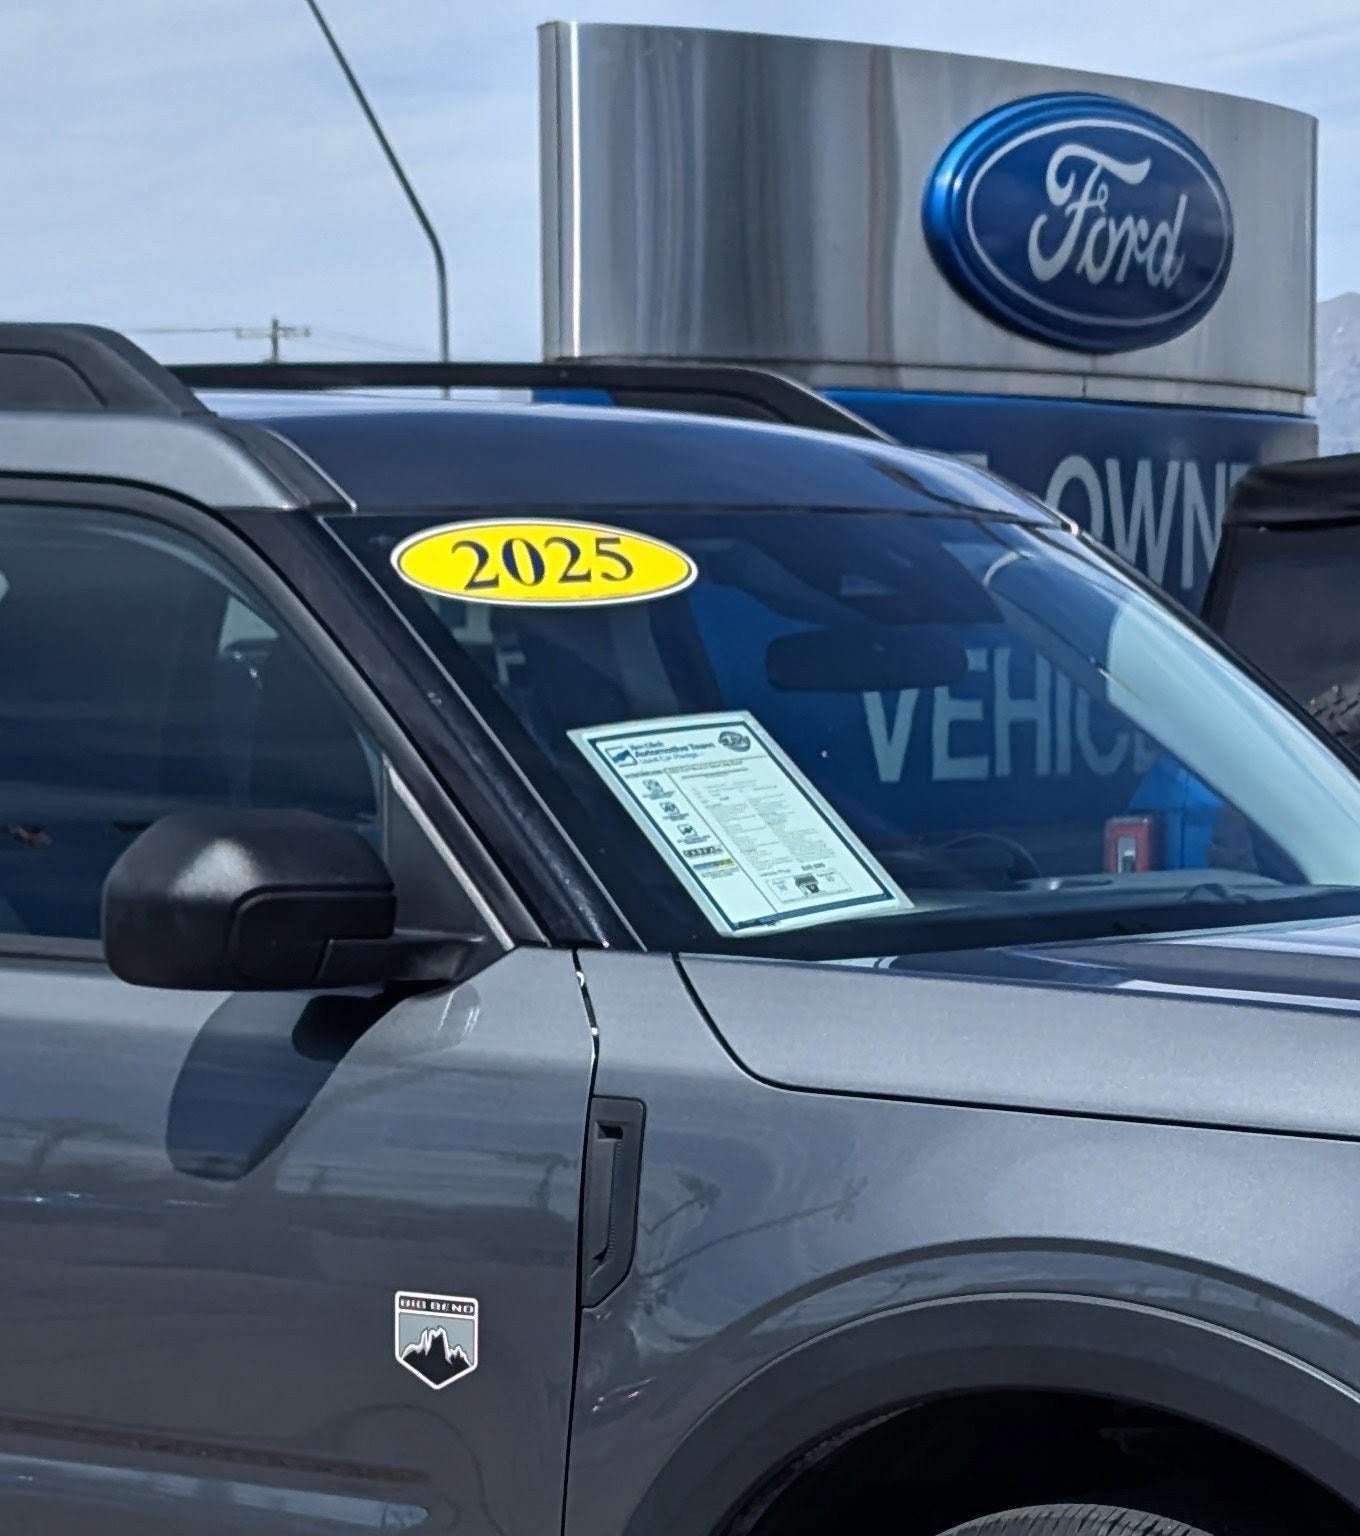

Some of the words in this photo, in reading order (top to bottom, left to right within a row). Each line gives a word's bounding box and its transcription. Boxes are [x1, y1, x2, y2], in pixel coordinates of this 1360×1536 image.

[1028, 143, 1188, 289] Ford
[451, 536, 634, 591] 2025
[1045, 454, 1251, 591] OWN
[430, 1301, 474, 1314] BEND
